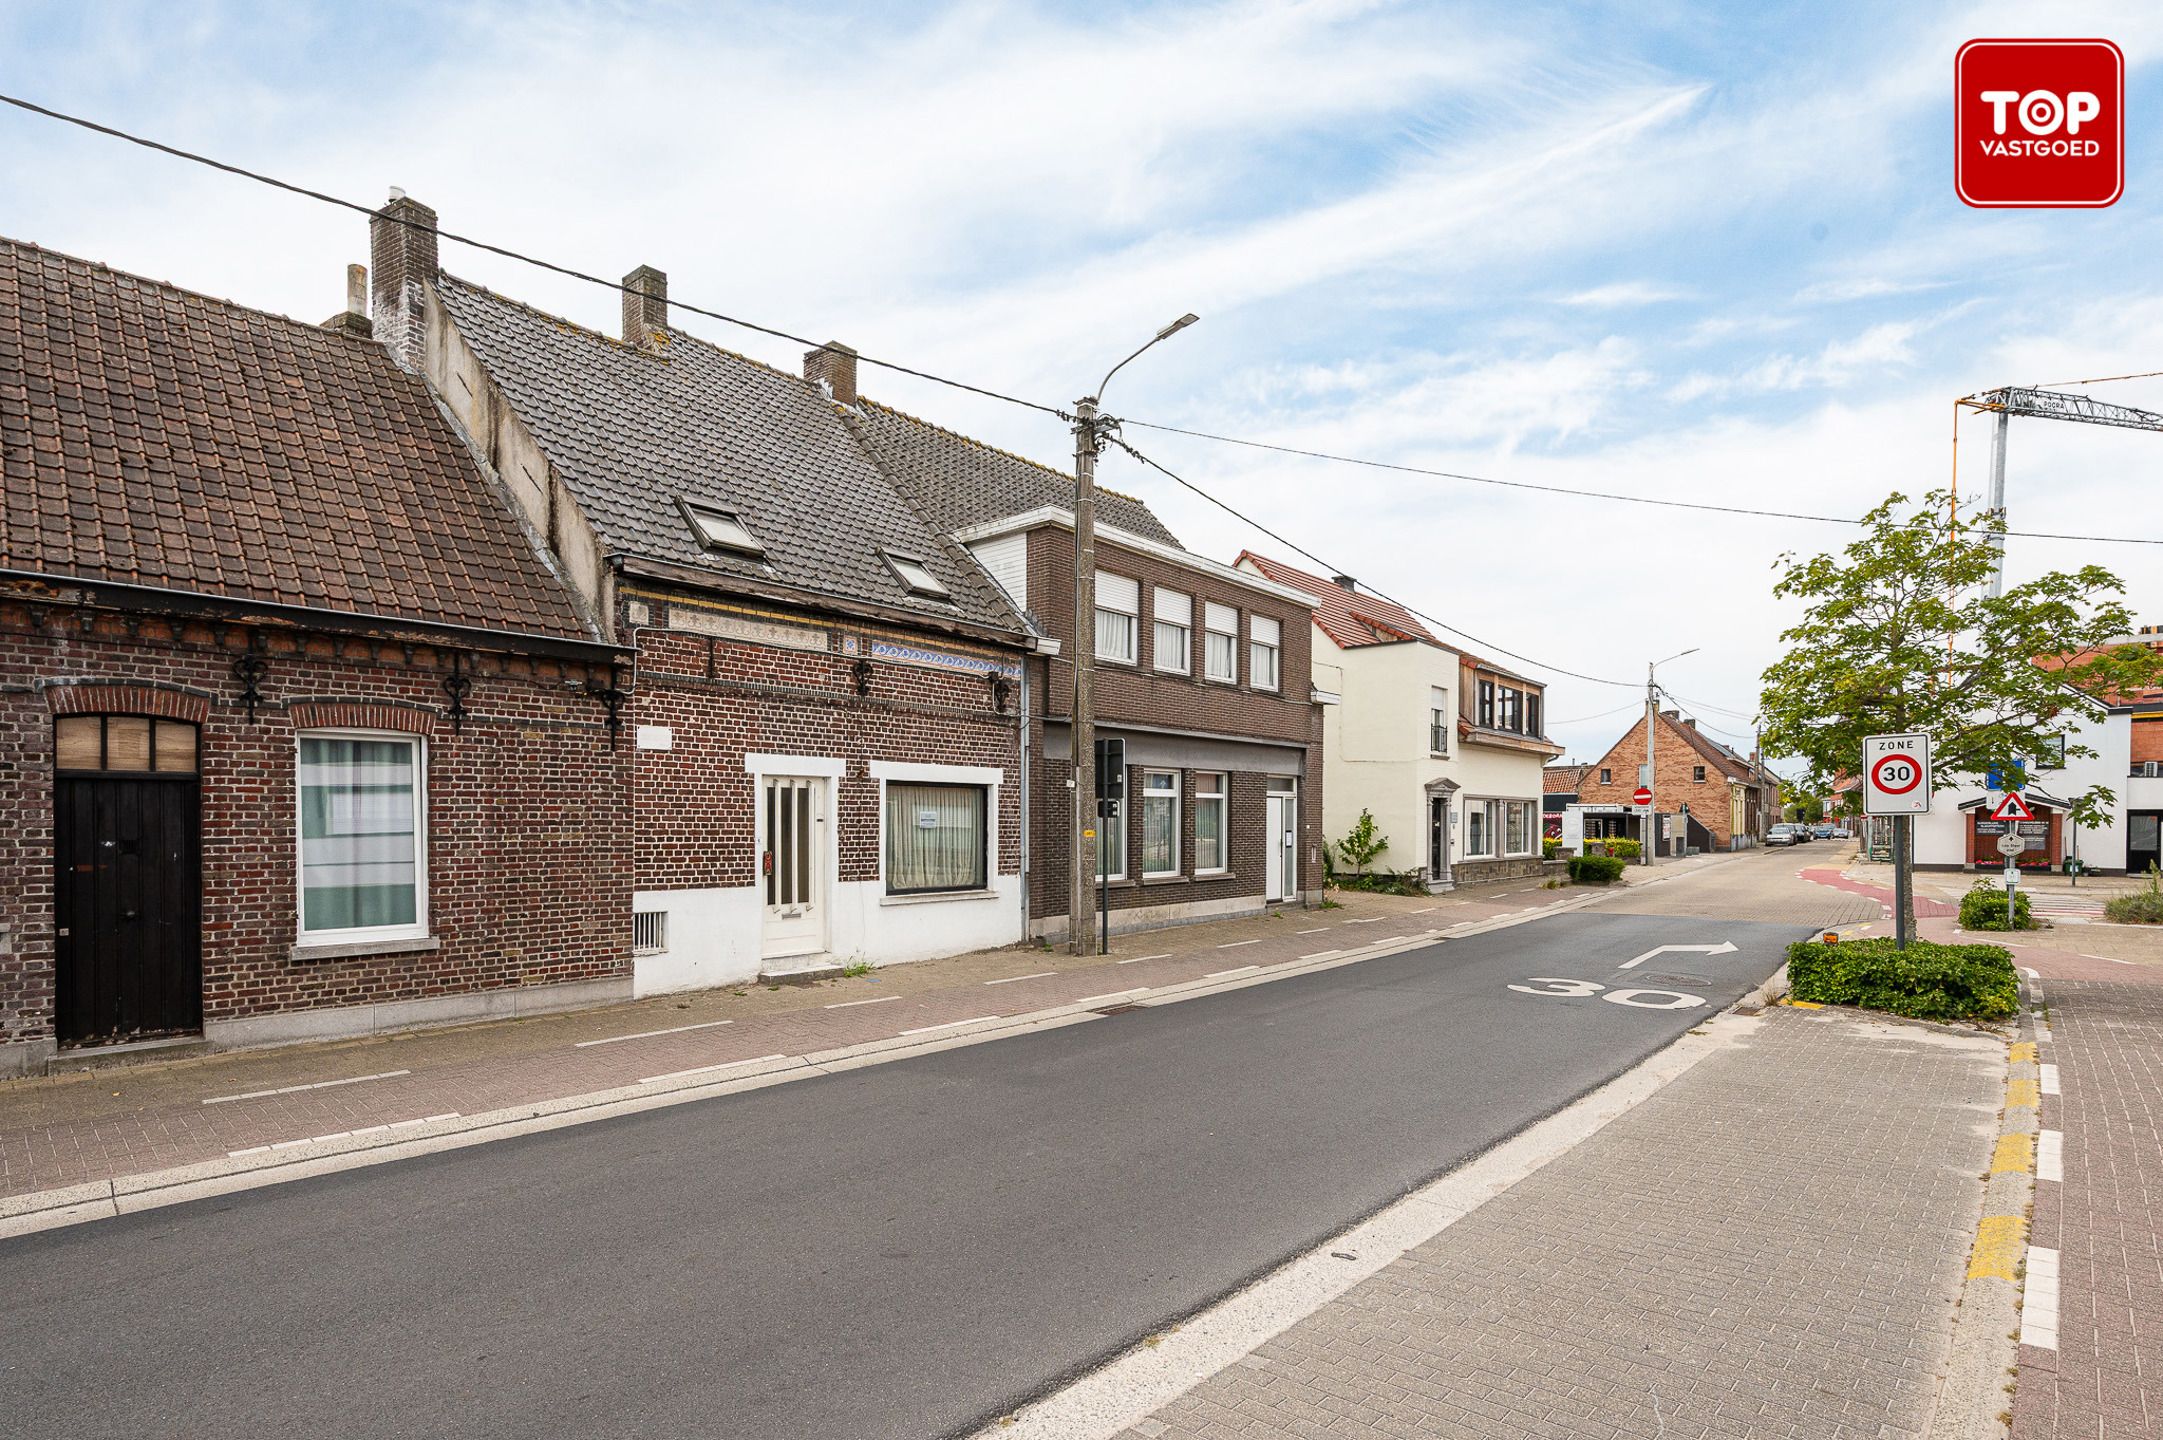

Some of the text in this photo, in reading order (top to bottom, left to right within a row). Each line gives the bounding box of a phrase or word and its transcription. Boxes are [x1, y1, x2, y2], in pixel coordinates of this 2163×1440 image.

[1879, 740, 1914, 751] ZONE
[1883, 766, 1910, 782] 30
[1506, 977, 1706, 1010] 30
